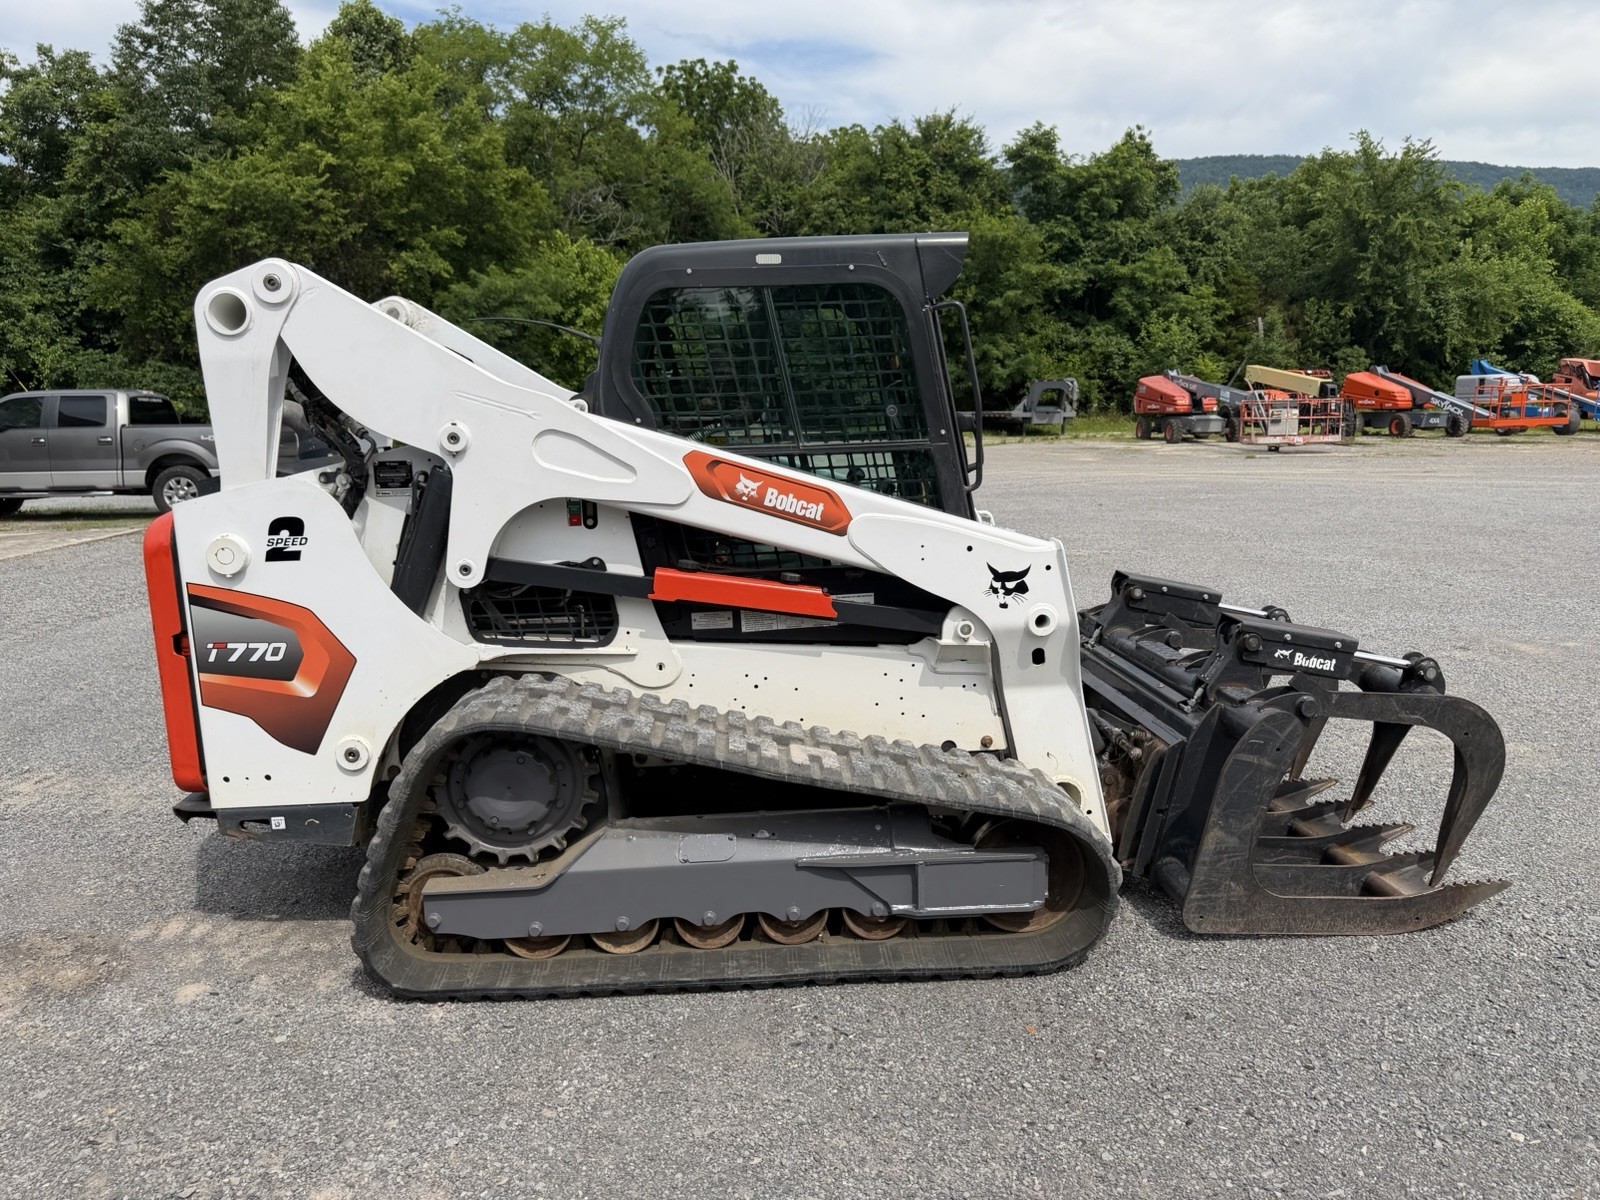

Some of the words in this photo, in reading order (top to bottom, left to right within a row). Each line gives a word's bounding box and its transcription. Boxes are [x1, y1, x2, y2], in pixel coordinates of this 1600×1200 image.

[1430, 397, 1463, 416] SKYJACK
[764, 487, 824, 521] Bobcat
[265, 516, 305, 562] 2
[267, 537, 308, 547] SPEED
[206, 642, 287, 662] T770
[1293, 652, 1336, 671] Bobcat
